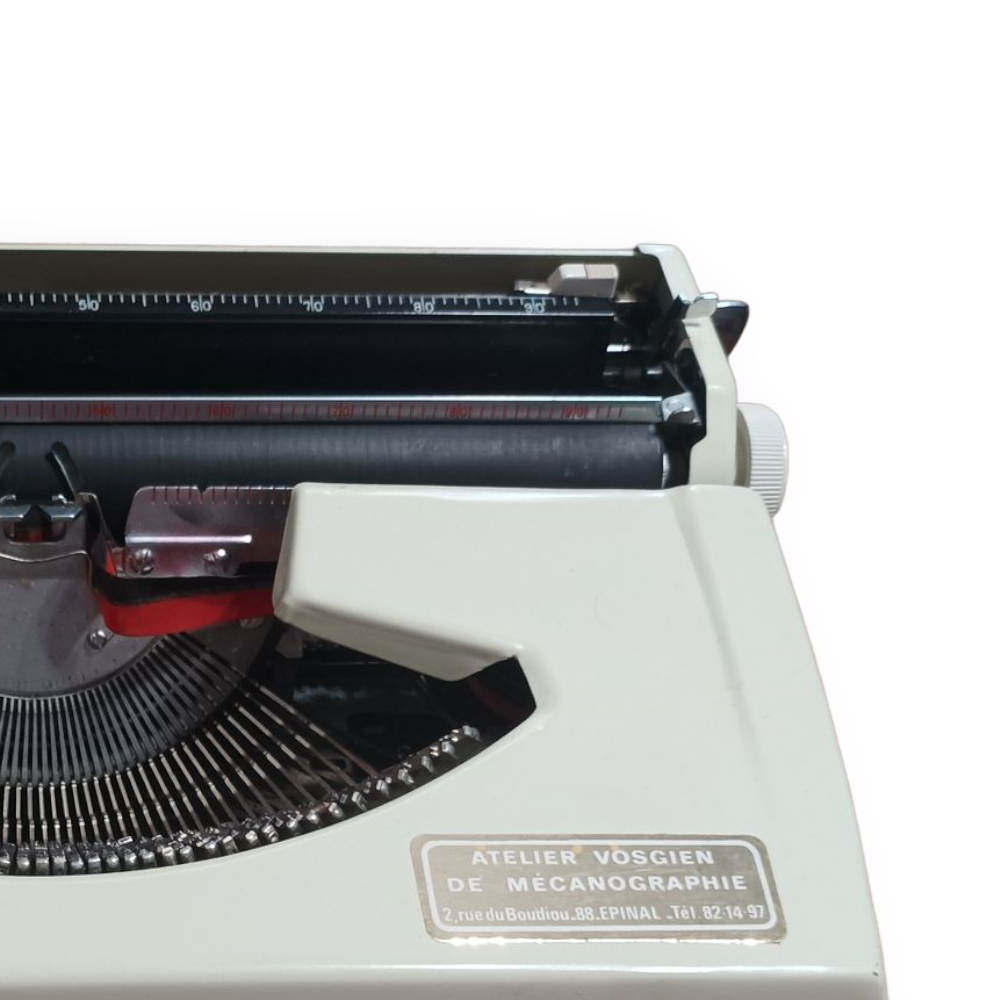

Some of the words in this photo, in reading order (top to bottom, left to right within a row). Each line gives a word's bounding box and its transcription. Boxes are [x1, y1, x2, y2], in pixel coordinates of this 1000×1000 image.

[78, 300, 99, 311] 50
[191, 301, 212, 312] 60
[302, 301, 323, 312] 70
[413, 302, 434, 313] 80
[524, 302, 545, 313] 90
[471, 850, 576, 865] ATELIER
[592, 850, 715, 865] VOSGIEN
[447, 877, 483, 892] DE
[507, 872, 748, 892] MÉCANOGRAPHIE
